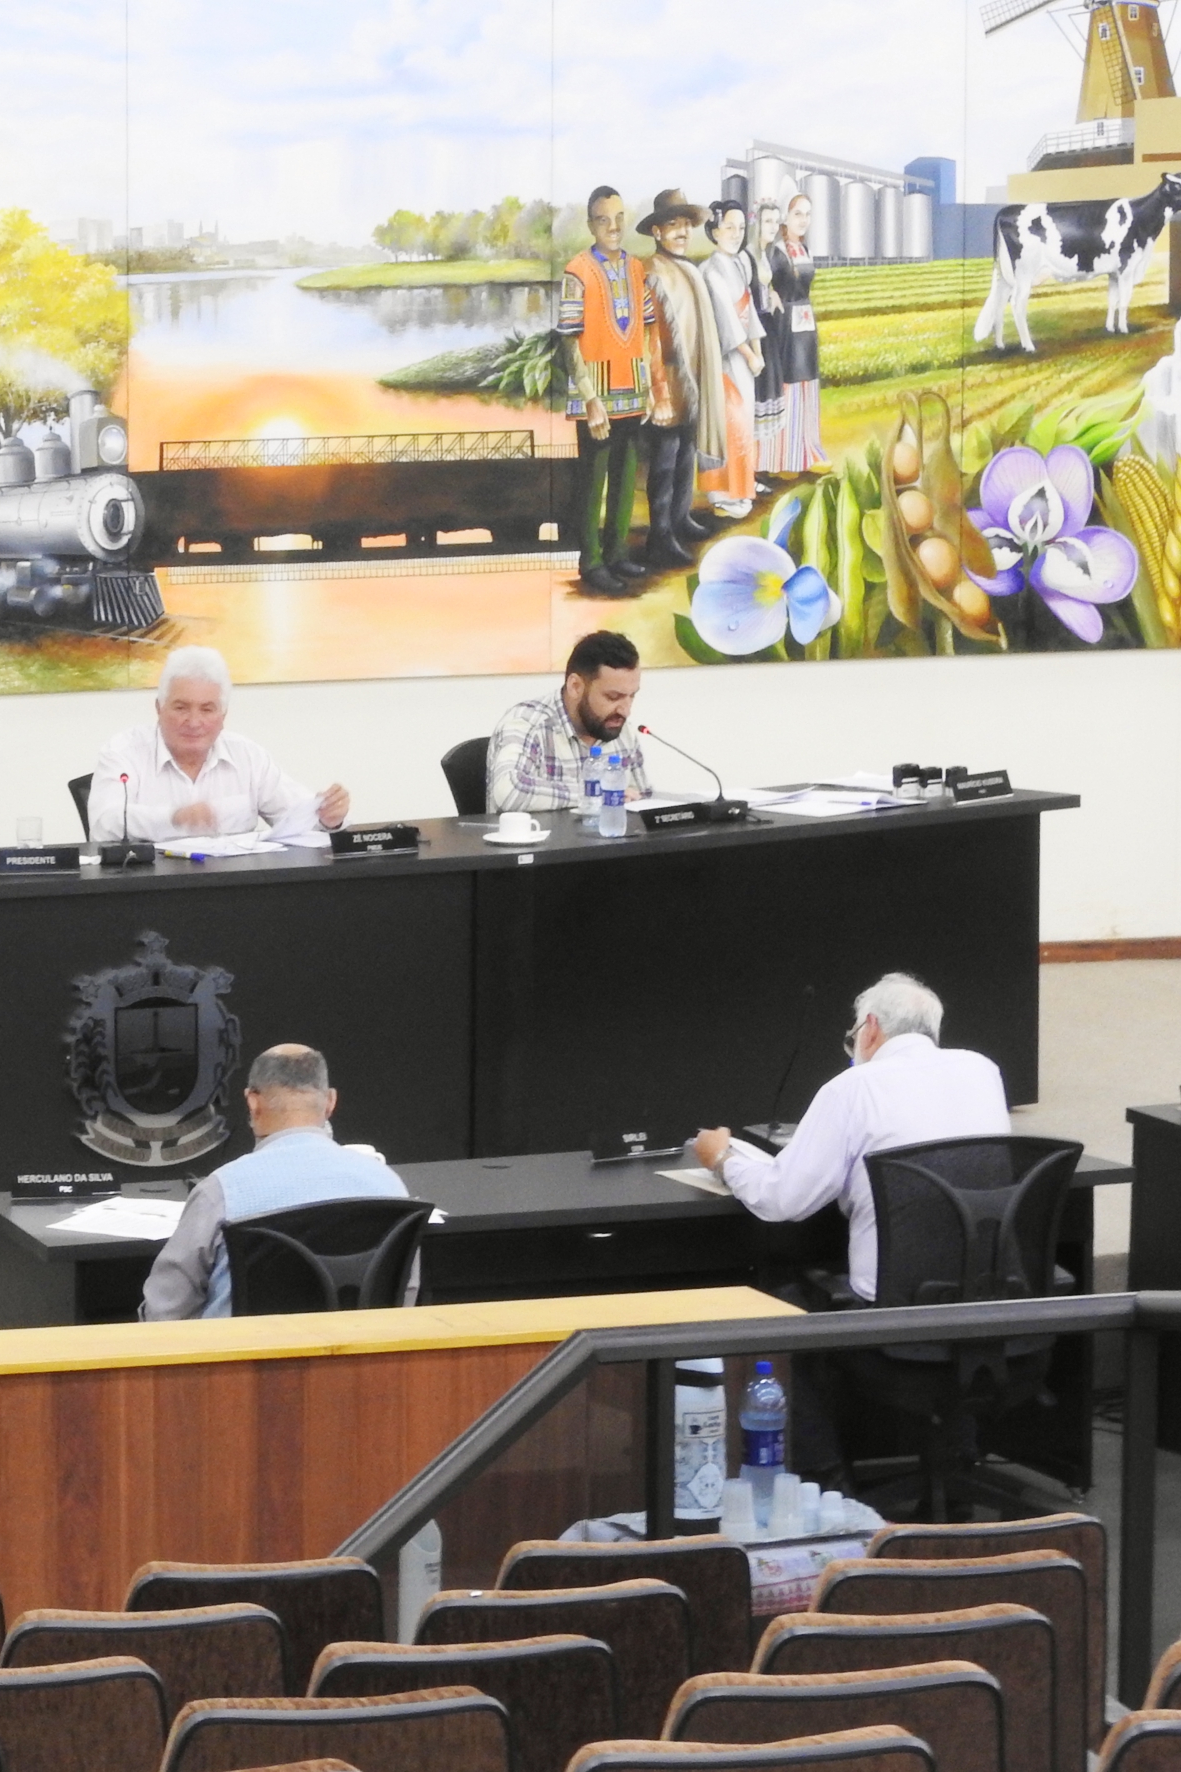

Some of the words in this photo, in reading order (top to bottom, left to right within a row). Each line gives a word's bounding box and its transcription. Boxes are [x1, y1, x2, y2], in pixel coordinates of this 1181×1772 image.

[6, 856, 56, 865] PRESIDENTE
[17, 1173, 73, 1184] HERCULANO
[74, 1173, 87, 1182] DA
[88, 1172, 114, 1182] SILVA
